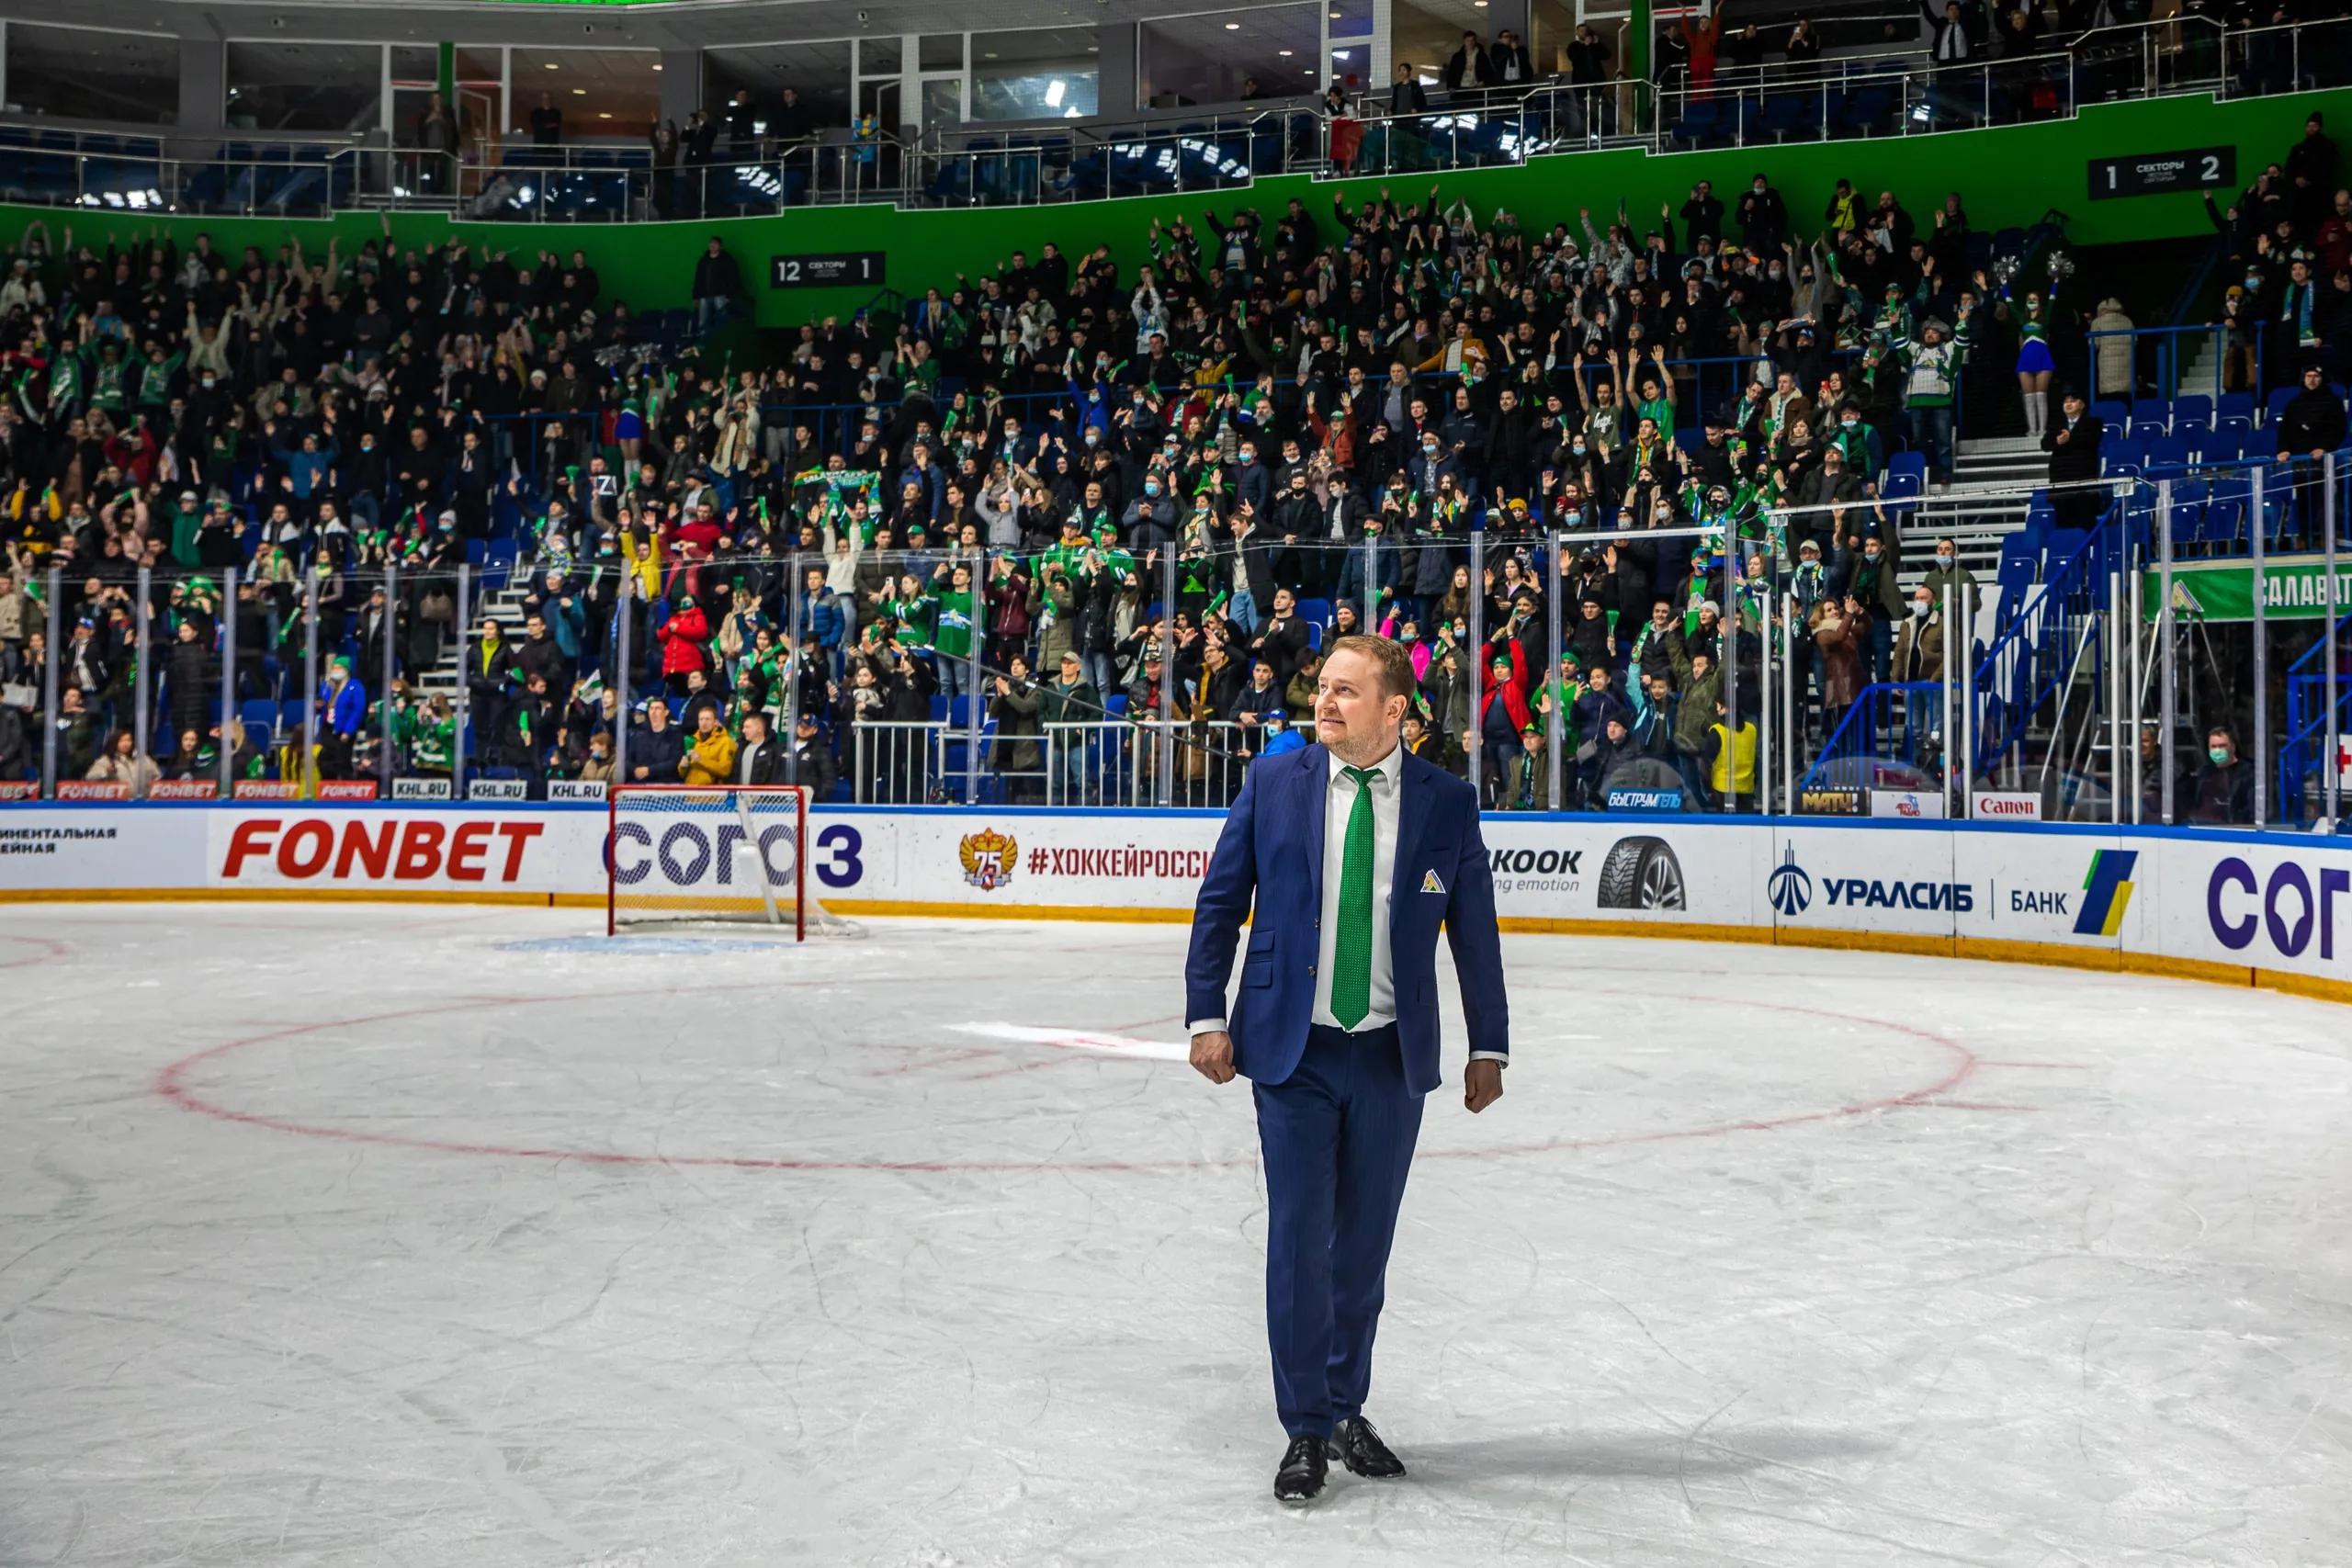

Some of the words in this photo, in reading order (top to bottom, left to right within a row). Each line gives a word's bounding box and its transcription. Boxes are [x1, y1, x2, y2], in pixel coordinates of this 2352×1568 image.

[2106, 165, 2117, 189] 1
[2136, 161, 2185, 174] СЕКТОРЫ
[2200, 155, 2220, 180] 2
[778, 261, 800, 282] 12
[808, 261, 846, 269] СЕКТОРЫ
[861, 258, 869, 278] 1
[58, 784, 127, 798] FONBET
[150, 784, 216, 797] FONBET
[234, 784, 300, 797] FONBET
[396, 783, 447, 795] KHL.RU
[472, 784, 523, 797] KHL.RU
[552, 784, 602, 797] KHL.RU
[1980, 797, 2034, 815] Canon
[221, 819, 544, 882] FONBET
[974, 852, 1002, 878] 75
[1487, 849, 1582, 874] KOOK
[1516, 879, 1579, 892] emotion
[1822, 878, 1973, 913] УРАЛСИБ
[2011, 890, 2068, 915] БАНК
